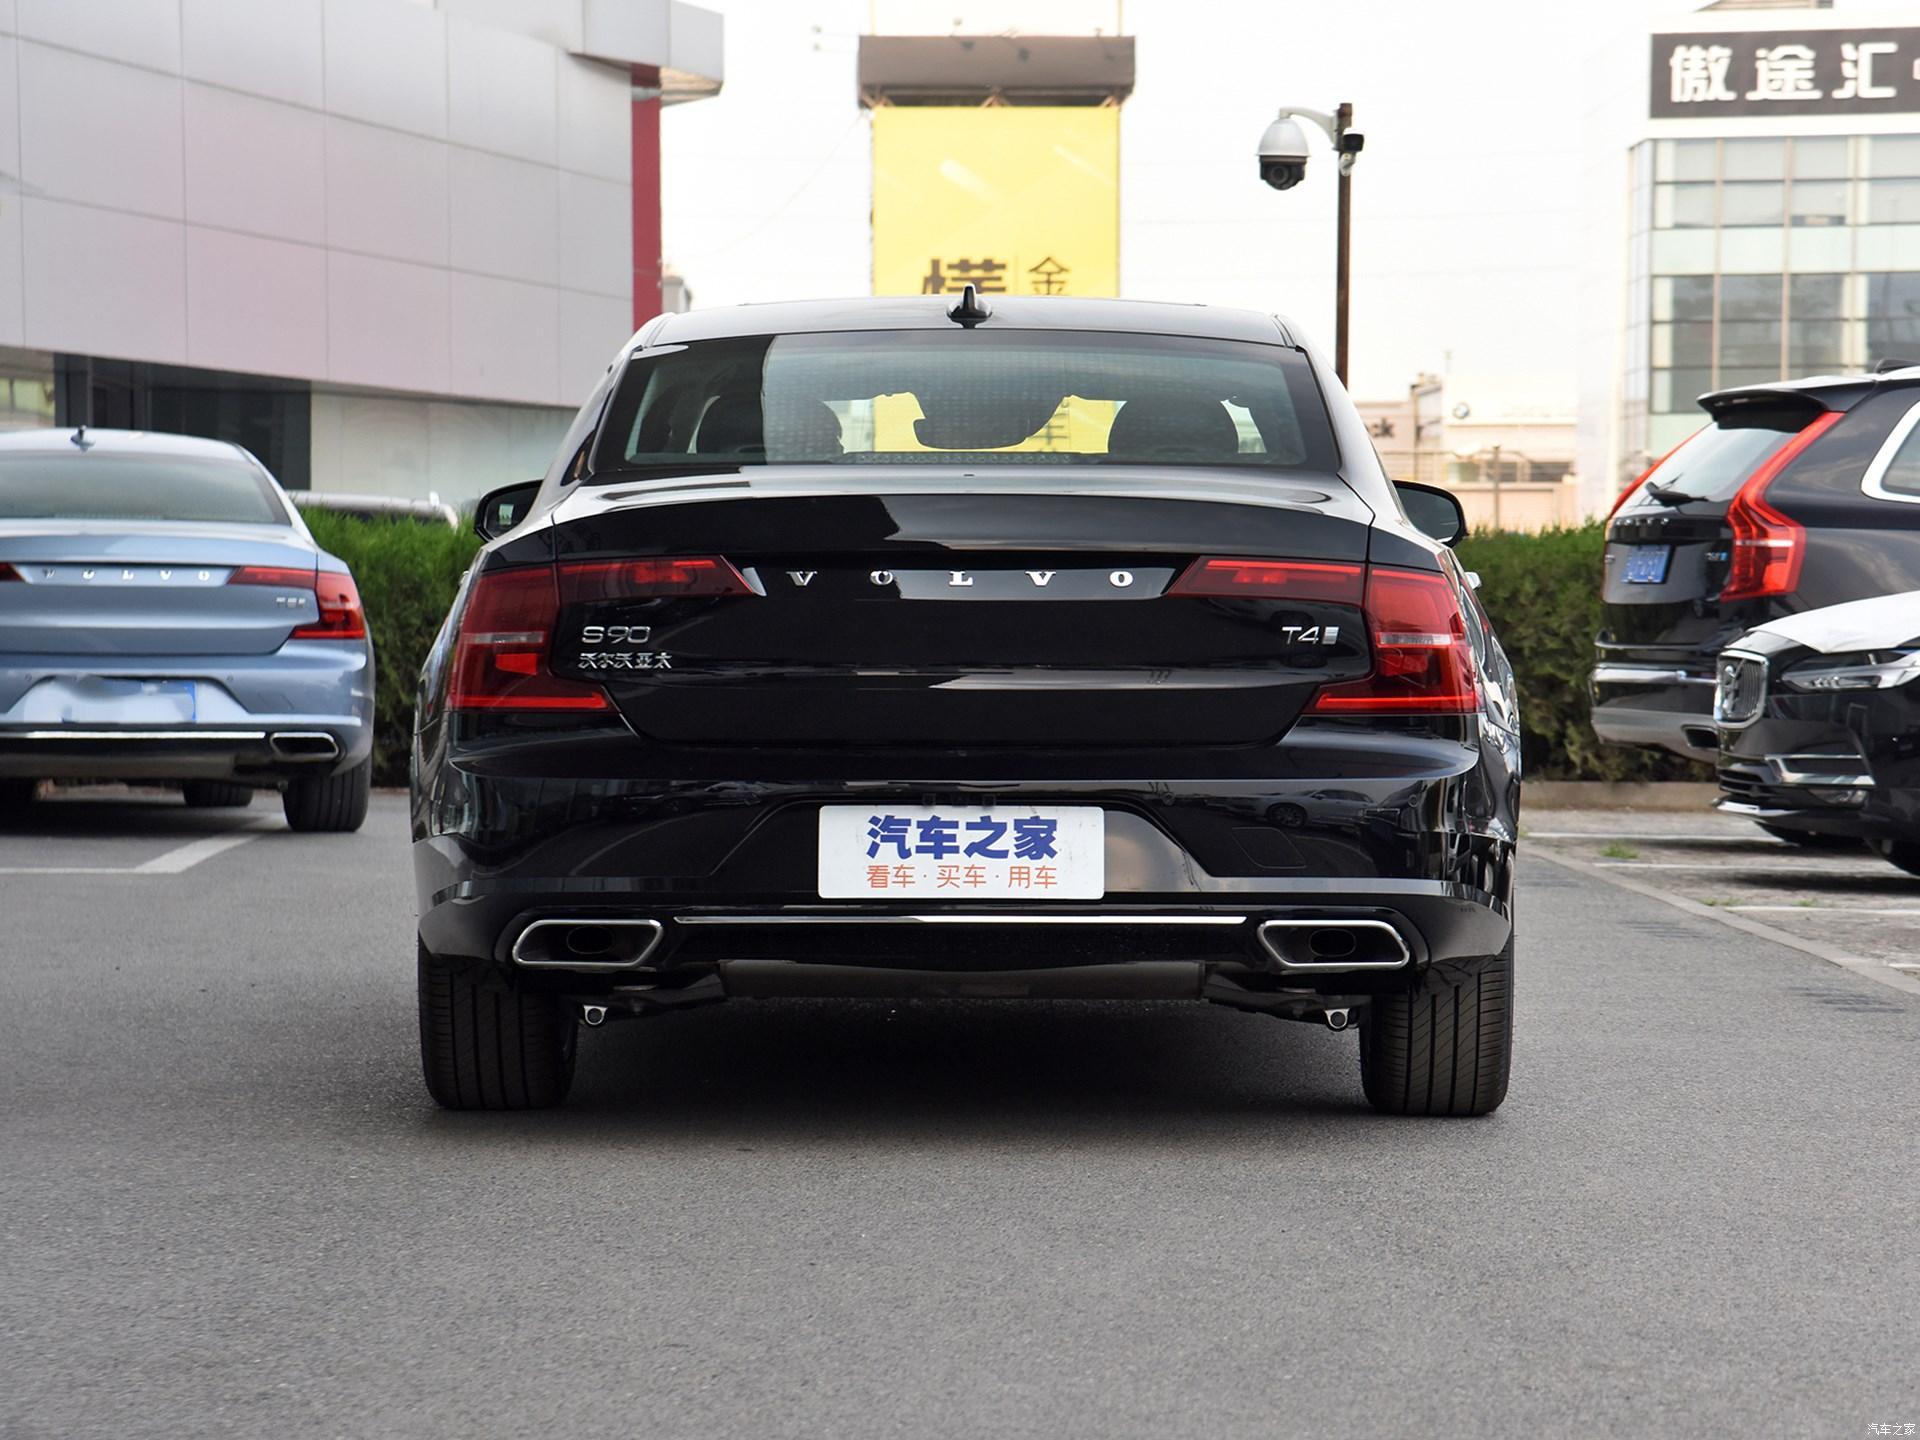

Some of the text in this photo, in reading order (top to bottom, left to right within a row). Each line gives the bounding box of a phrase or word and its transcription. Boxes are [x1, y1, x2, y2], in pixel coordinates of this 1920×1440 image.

[1669, 42, 1920, 102] 傲途汇
[785, 570, 1134, 587] VOLVO
[581, 625, 651, 644] S90
[1281, 626, 1320, 645] T4
[577, 651, 673, 670] 沃尔沃亚太
[866, 814, 1059, 861] 汽车之家
